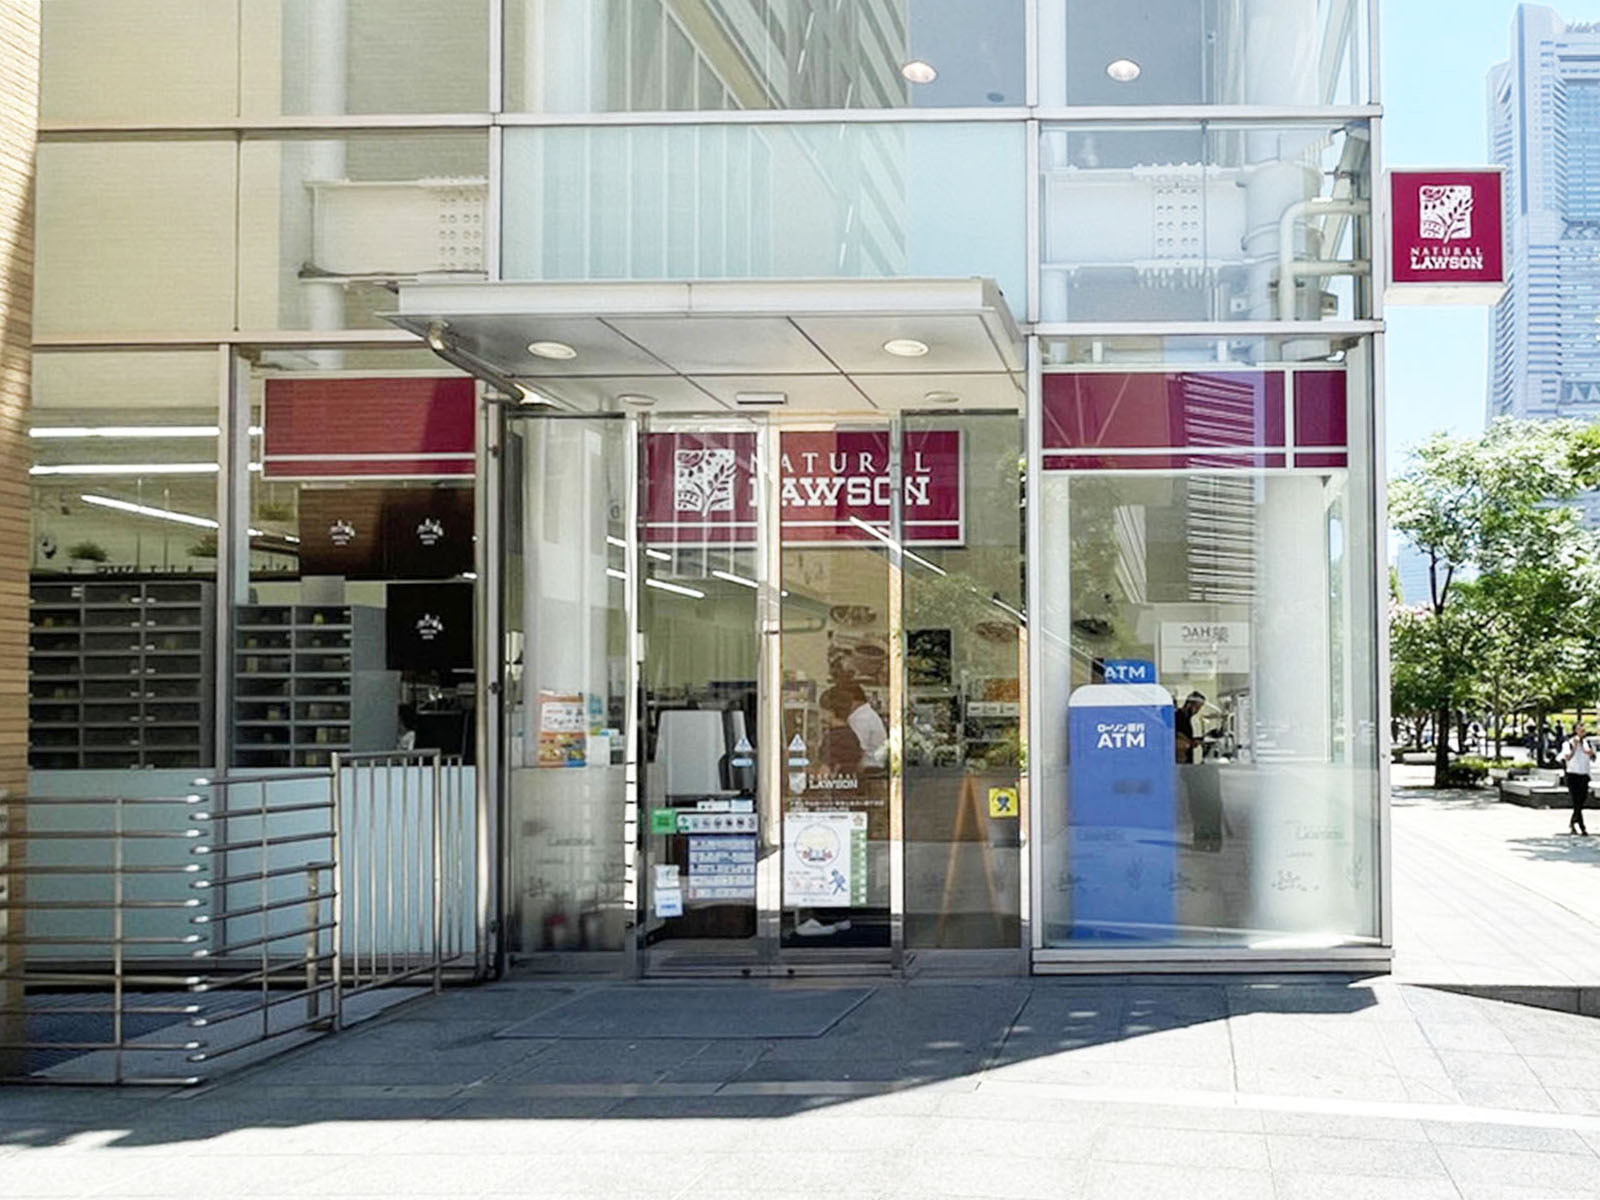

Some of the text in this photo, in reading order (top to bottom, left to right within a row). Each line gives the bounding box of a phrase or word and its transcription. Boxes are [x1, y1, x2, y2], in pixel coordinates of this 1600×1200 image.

[1410, 246, 1482, 255] NATURAL
[1410, 256, 1483, 269] LAWSON
[1104, 665, 1145, 680] ATM
[1097, 733, 1145, 749] ATM
